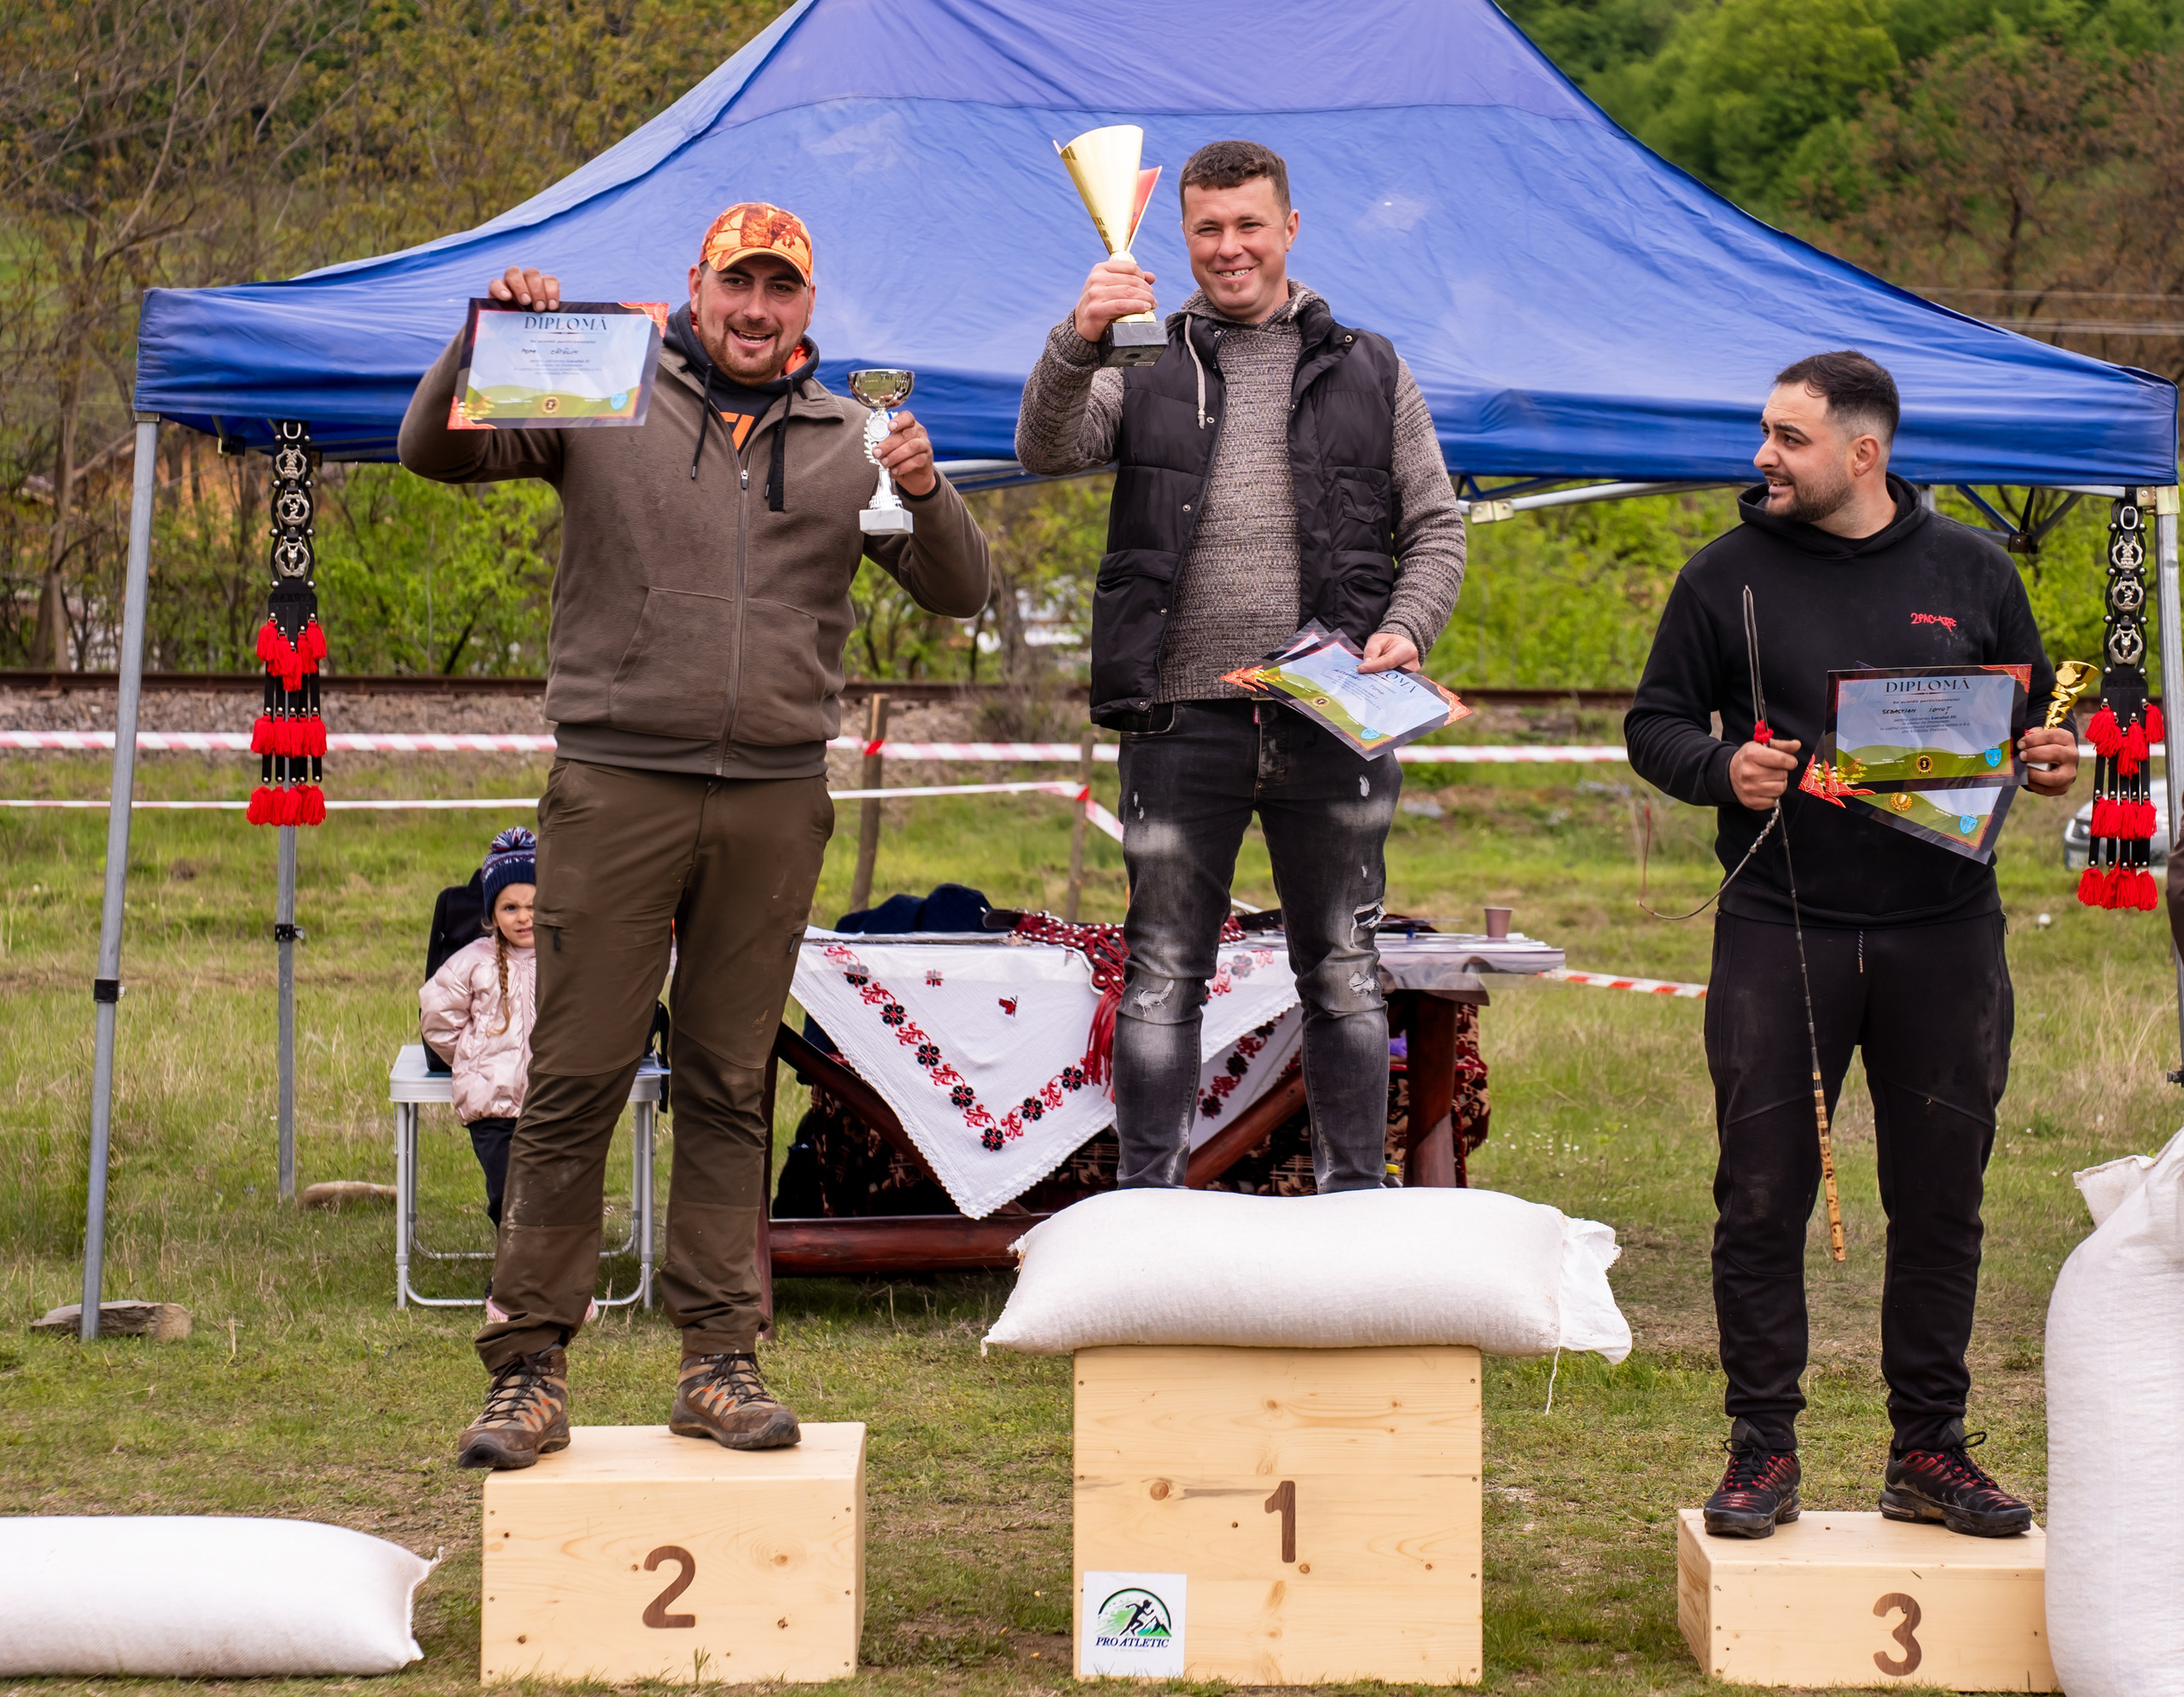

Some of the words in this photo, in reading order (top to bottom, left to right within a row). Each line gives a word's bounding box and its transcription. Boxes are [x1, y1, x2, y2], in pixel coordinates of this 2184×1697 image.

[524, 316, 607, 331] DIPLOMĂ
[1885, 677, 1970, 693] DIPLOMĂ
[1264, 1480, 1296, 1563] 1
[642, 1545, 696, 1629] 2
[1095, 1637, 1118, 1647] PRO
[1118, 1637, 1170, 1648] ATLETIC
[1873, 1592, 1922, 1677] 3
